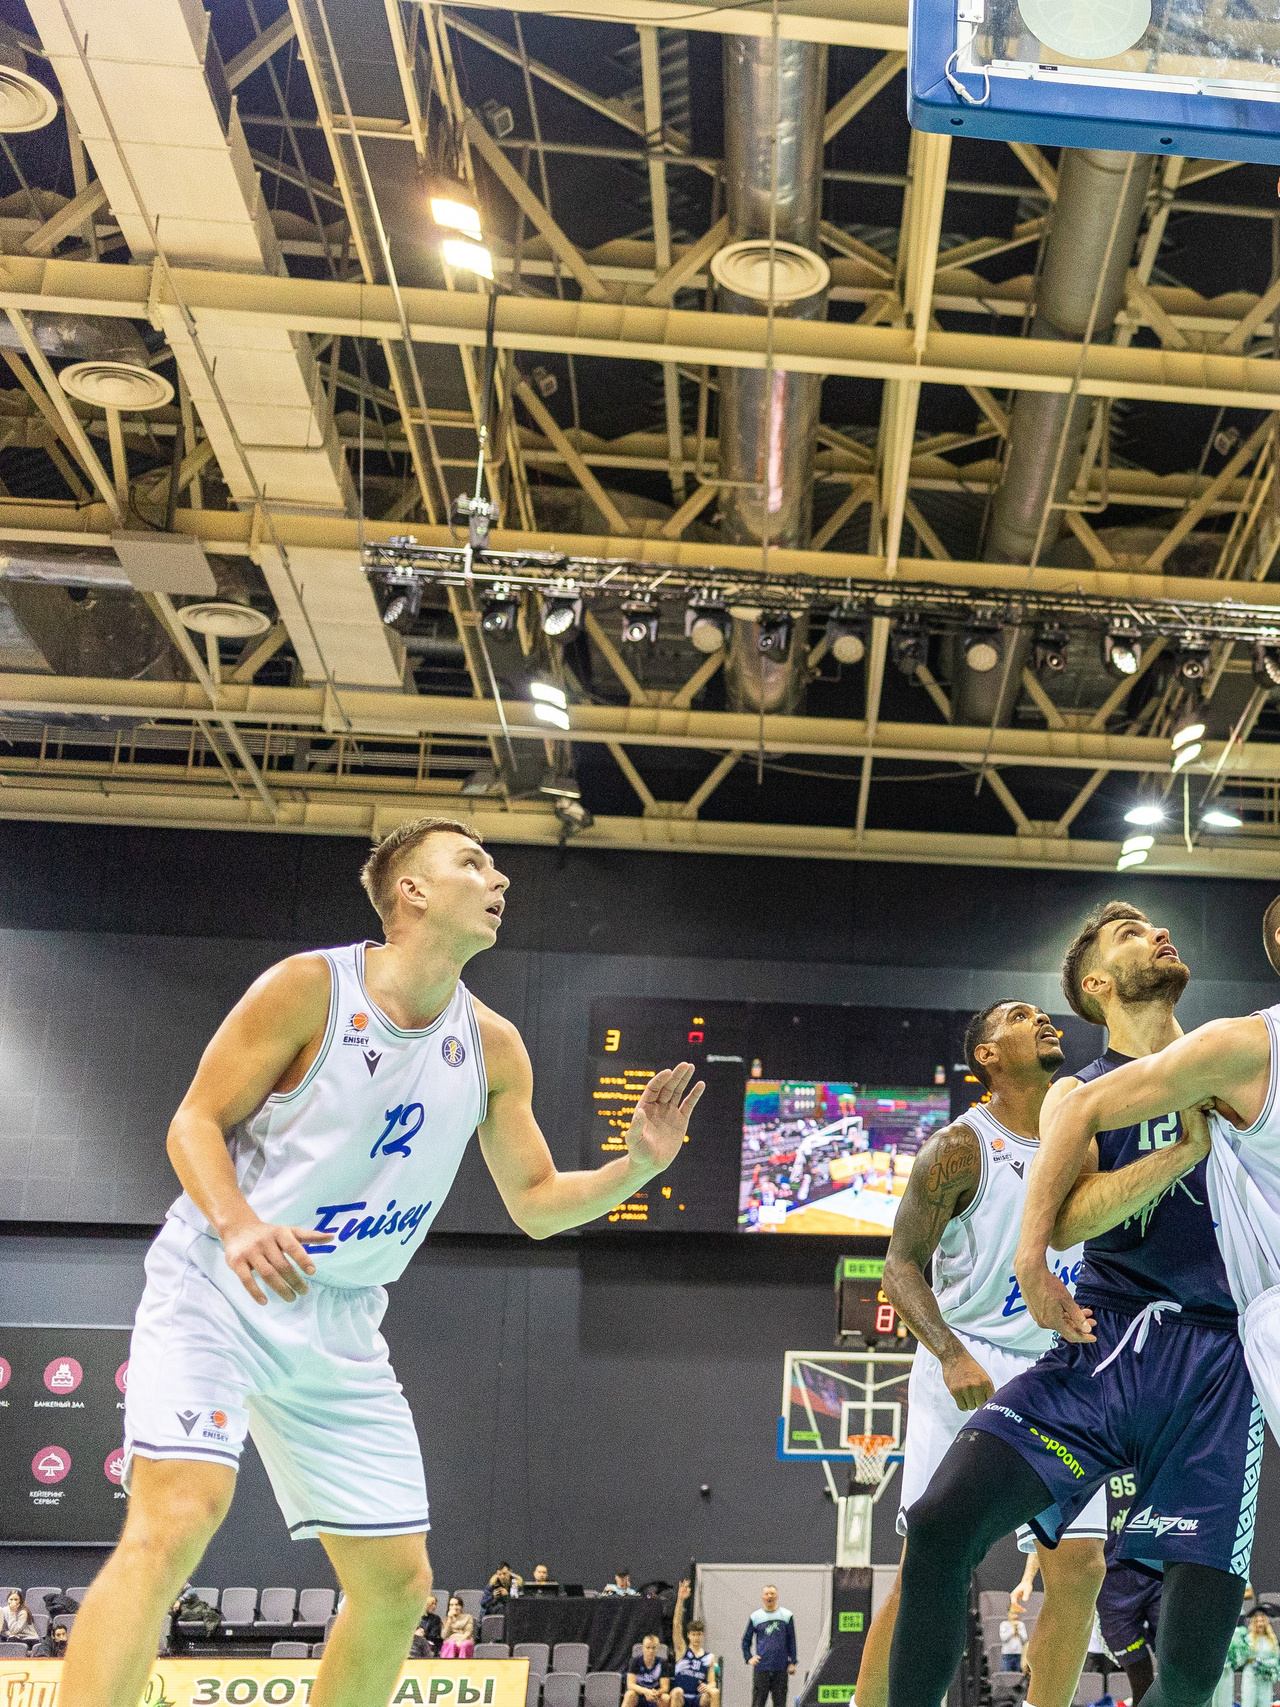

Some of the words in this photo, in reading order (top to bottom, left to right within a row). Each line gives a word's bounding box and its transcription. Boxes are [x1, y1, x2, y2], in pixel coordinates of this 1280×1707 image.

[343, 1035, 369, 1045] ENISEY
[604, 1029, 621, 1052] 3
[370, 1103, 425, 1159] 12
[1138, 1111, 1178, 1150] 12
[302, 1199, 433, 1255] Enisey
[875, 1304, 896, 1333] 8
[34, 1400, 70, 1408] БАНКЕТНЫЙ
[71, 1401, 85, 1409] ЗАЛ
[982, 1402, 1023, 1423] Kempa
[1109, 1473, 1137, 1499] 95
[192, 1678, 496, 1704] ЗООТАРЫ
